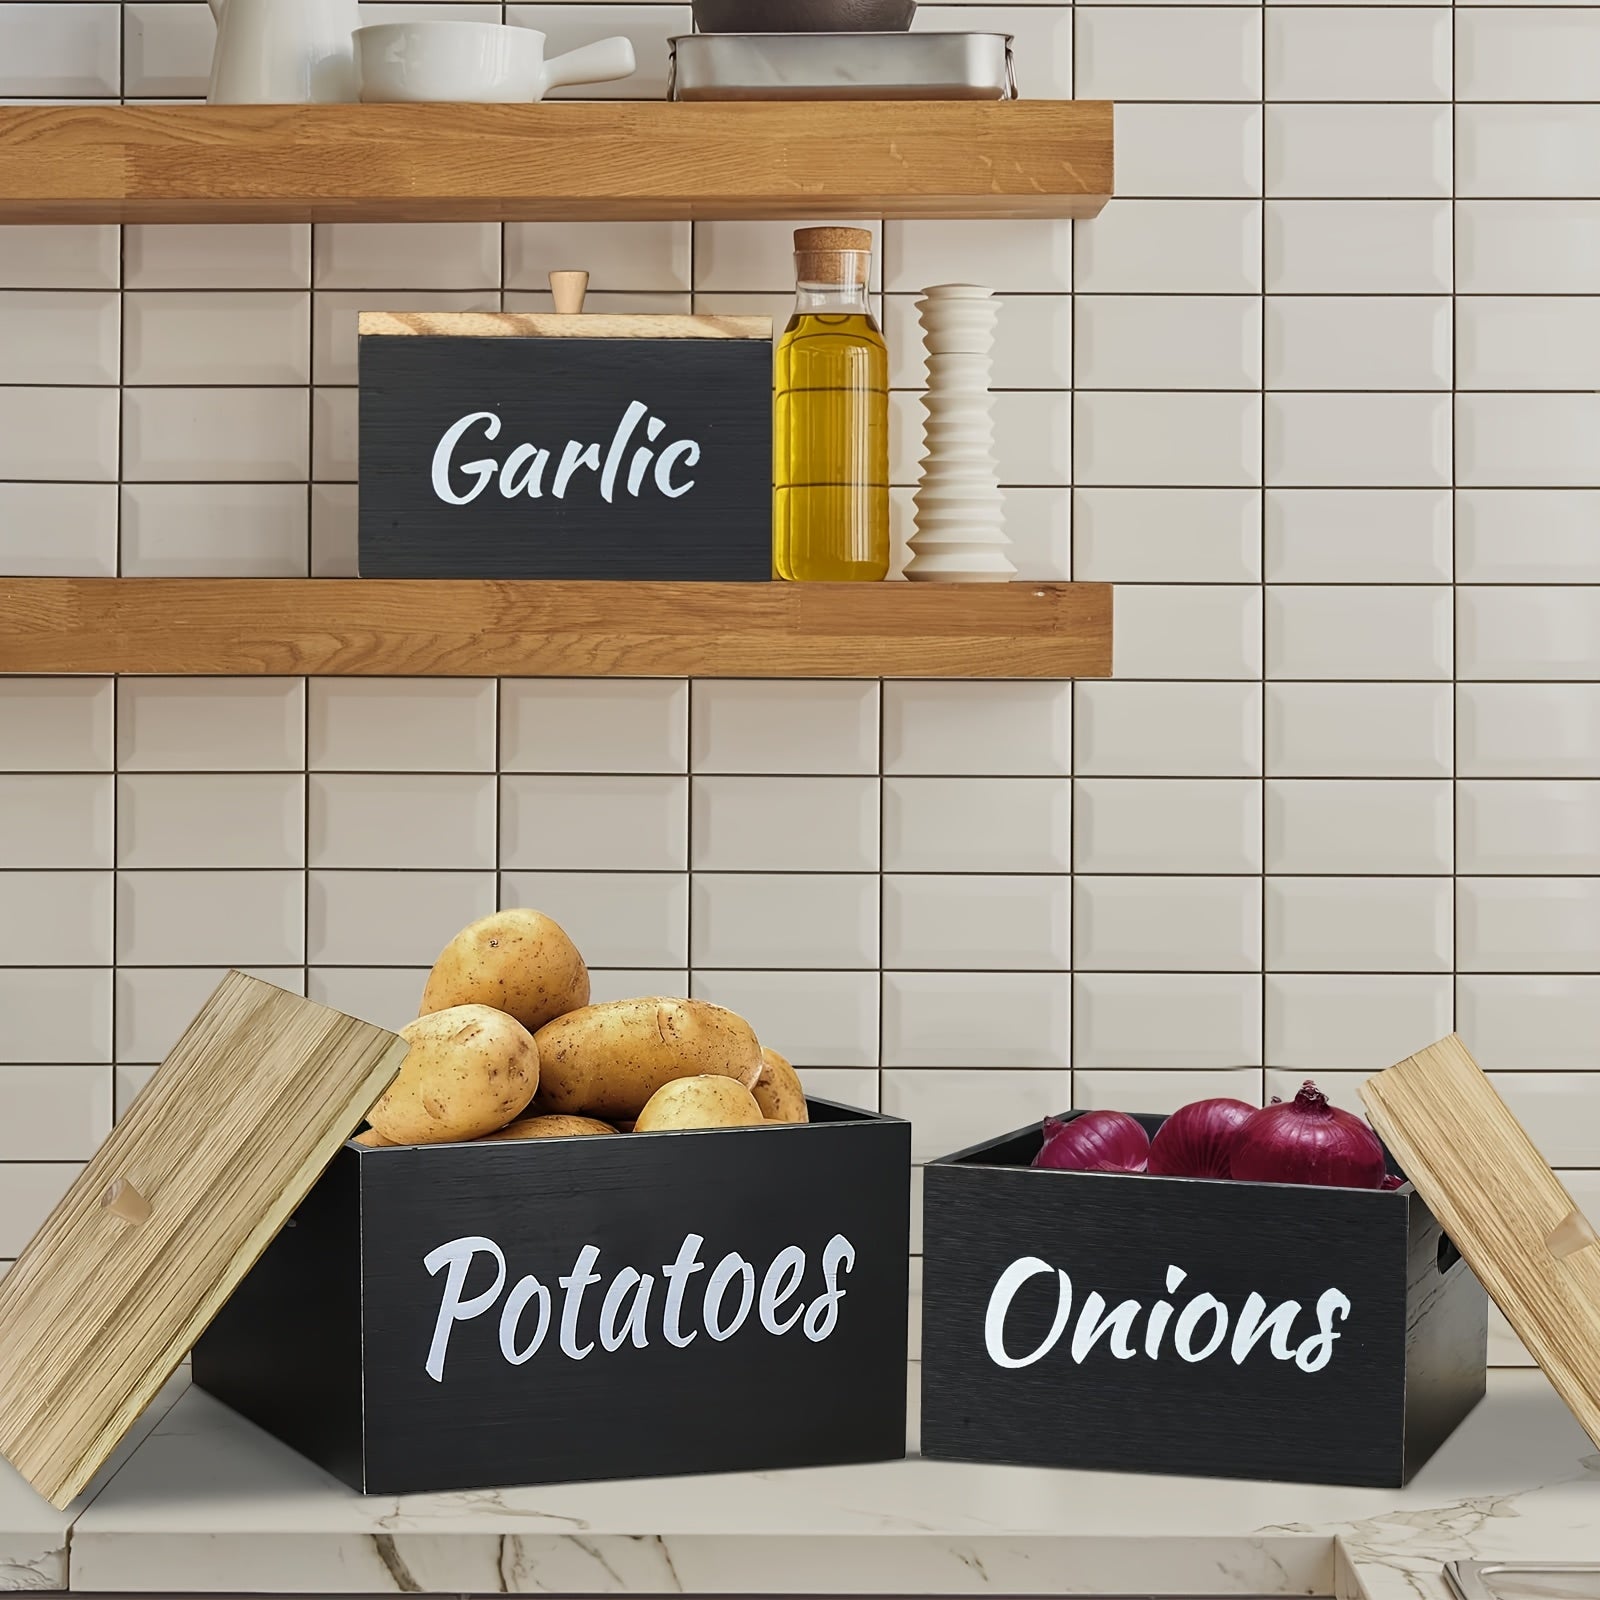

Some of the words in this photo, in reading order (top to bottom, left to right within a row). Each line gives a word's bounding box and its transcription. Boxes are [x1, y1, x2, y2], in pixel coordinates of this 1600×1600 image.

[431, 400, 701, 505] Garlic
[423, 1233, 856, 1383] Potatoes
[984, 1256, 1351, 1373] Onions
